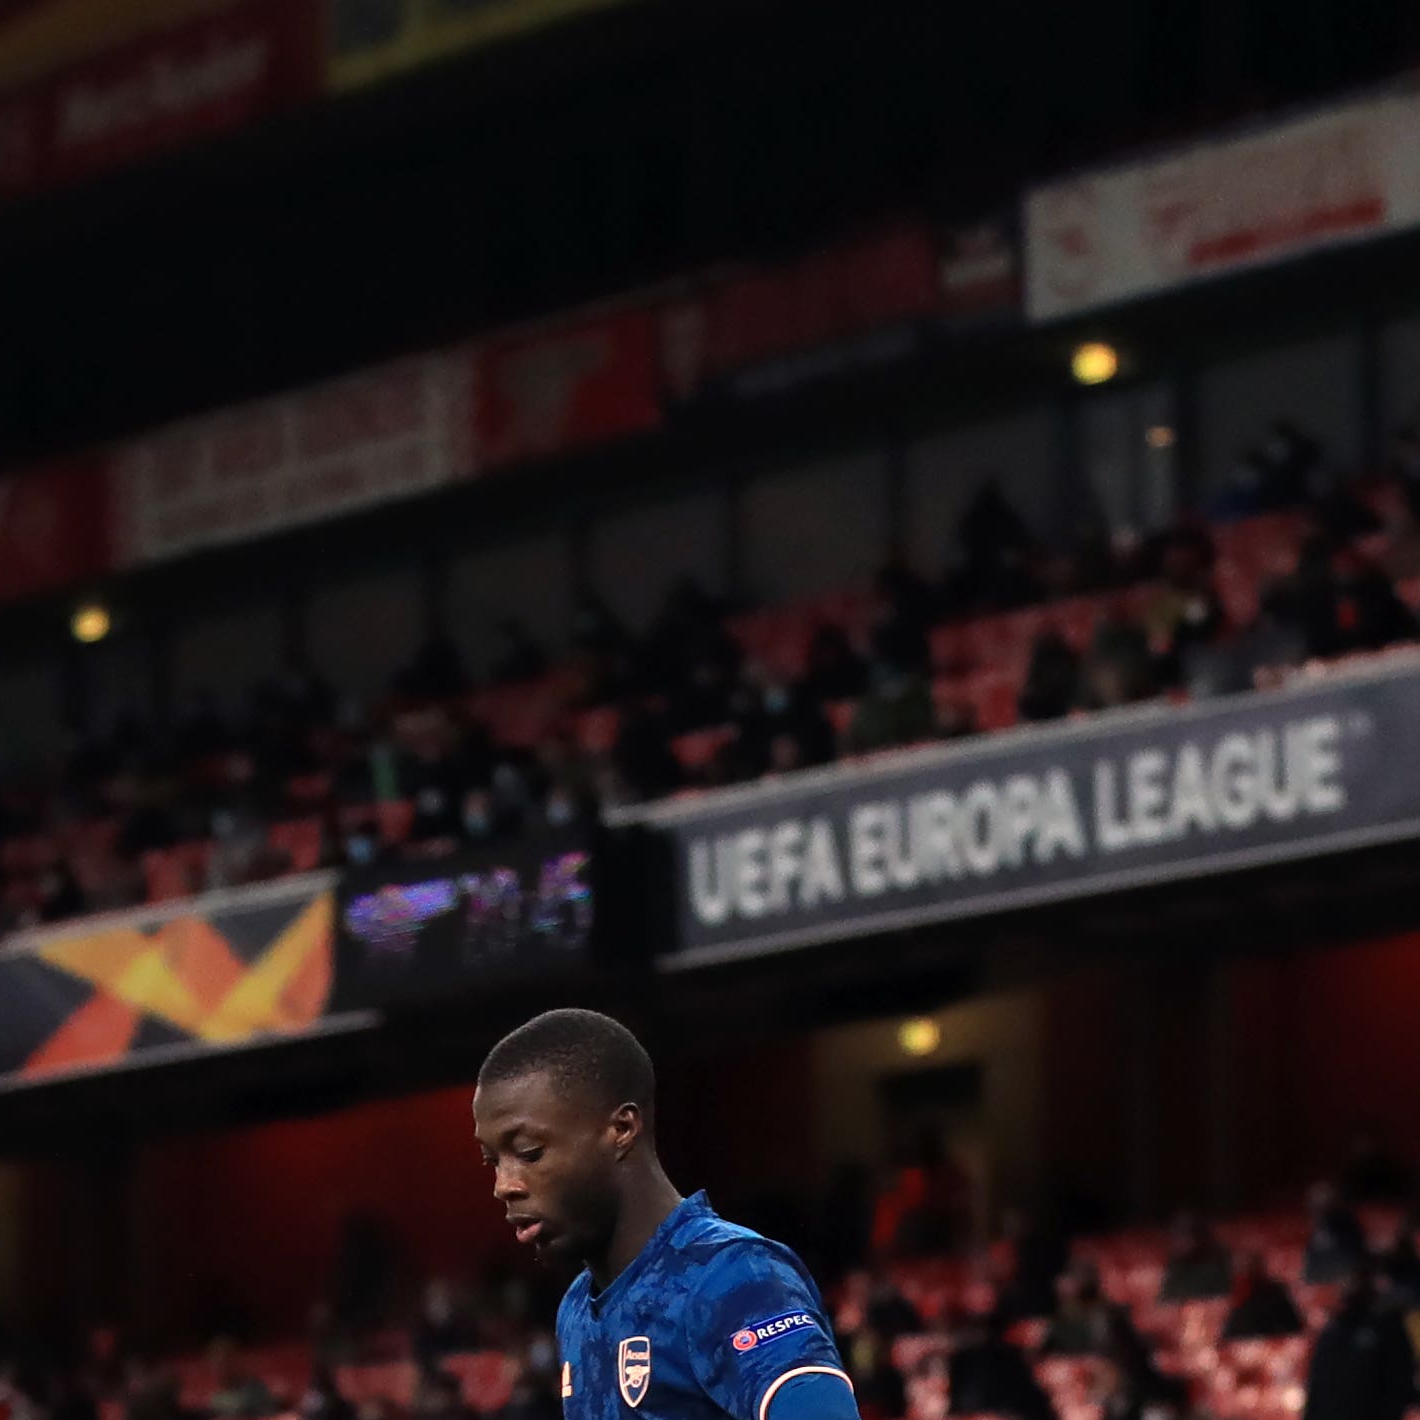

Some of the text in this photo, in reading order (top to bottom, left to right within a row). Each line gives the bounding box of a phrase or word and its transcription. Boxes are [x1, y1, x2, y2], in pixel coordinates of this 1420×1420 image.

[688, 820, 844, 925] UEFA
[848, 766, 1086, 894] EUROPA
[1094, 716, 1345, 851] LEAGUE
